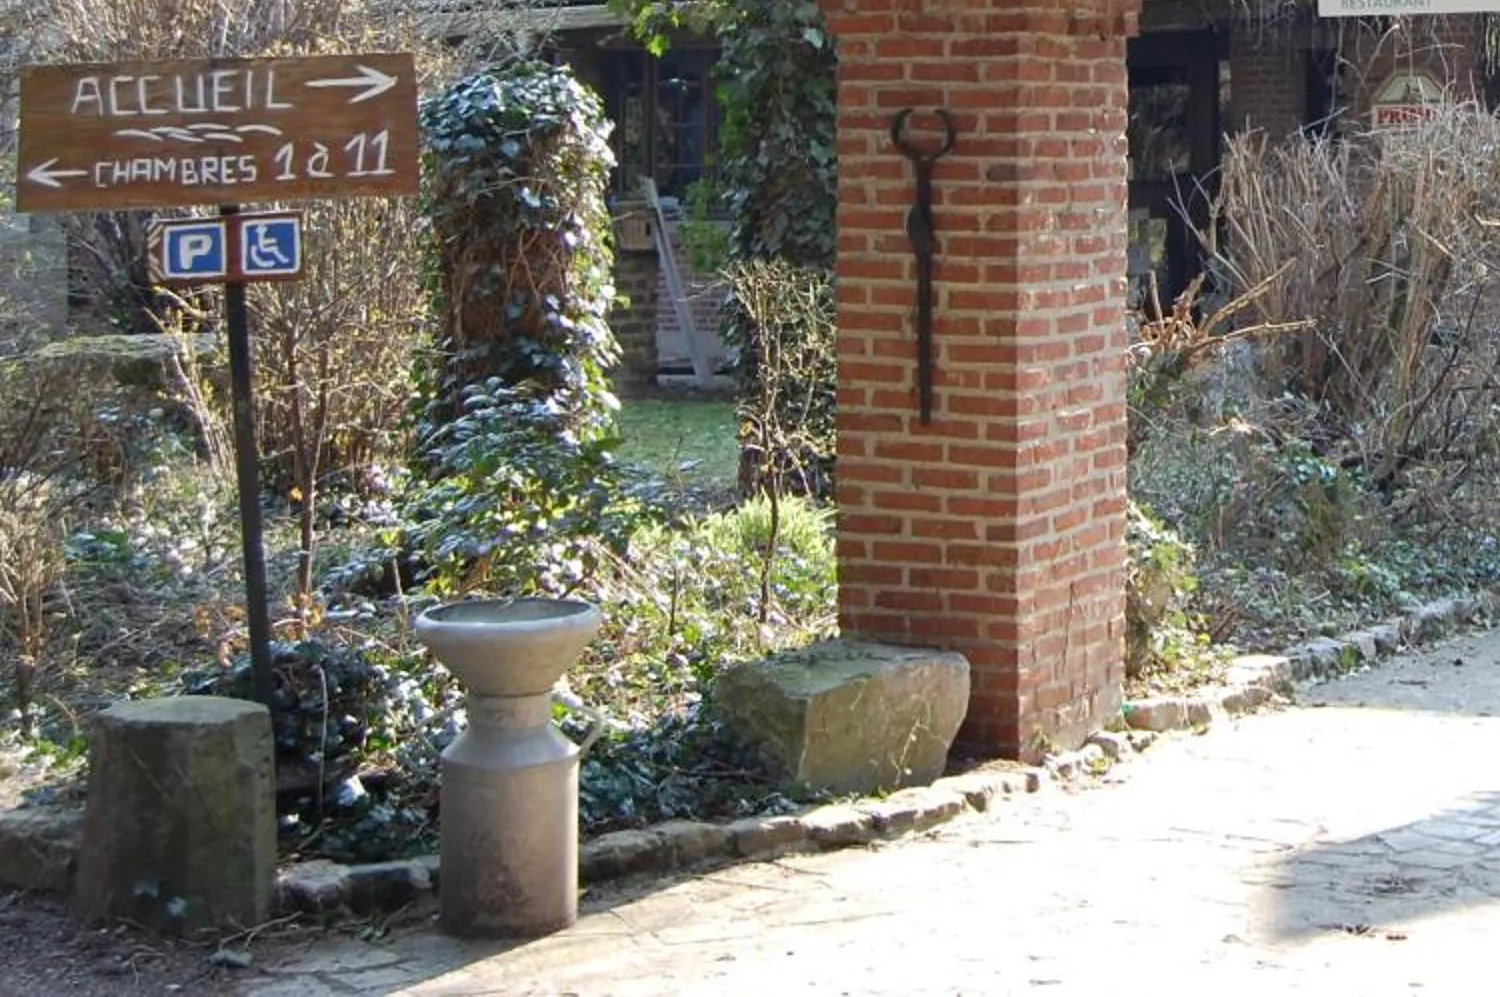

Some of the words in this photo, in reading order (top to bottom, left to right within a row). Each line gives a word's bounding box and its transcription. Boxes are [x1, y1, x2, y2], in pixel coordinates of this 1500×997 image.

[70, 66, 294, 116] ACCUEIL
[94, 154, 257, 188] CHAMBRES
[274, 141, 298, 181] 1
[307, 142, 335, 179] à
[344, 128, 396, 178] 11
[178, 234, 213, 270] P
